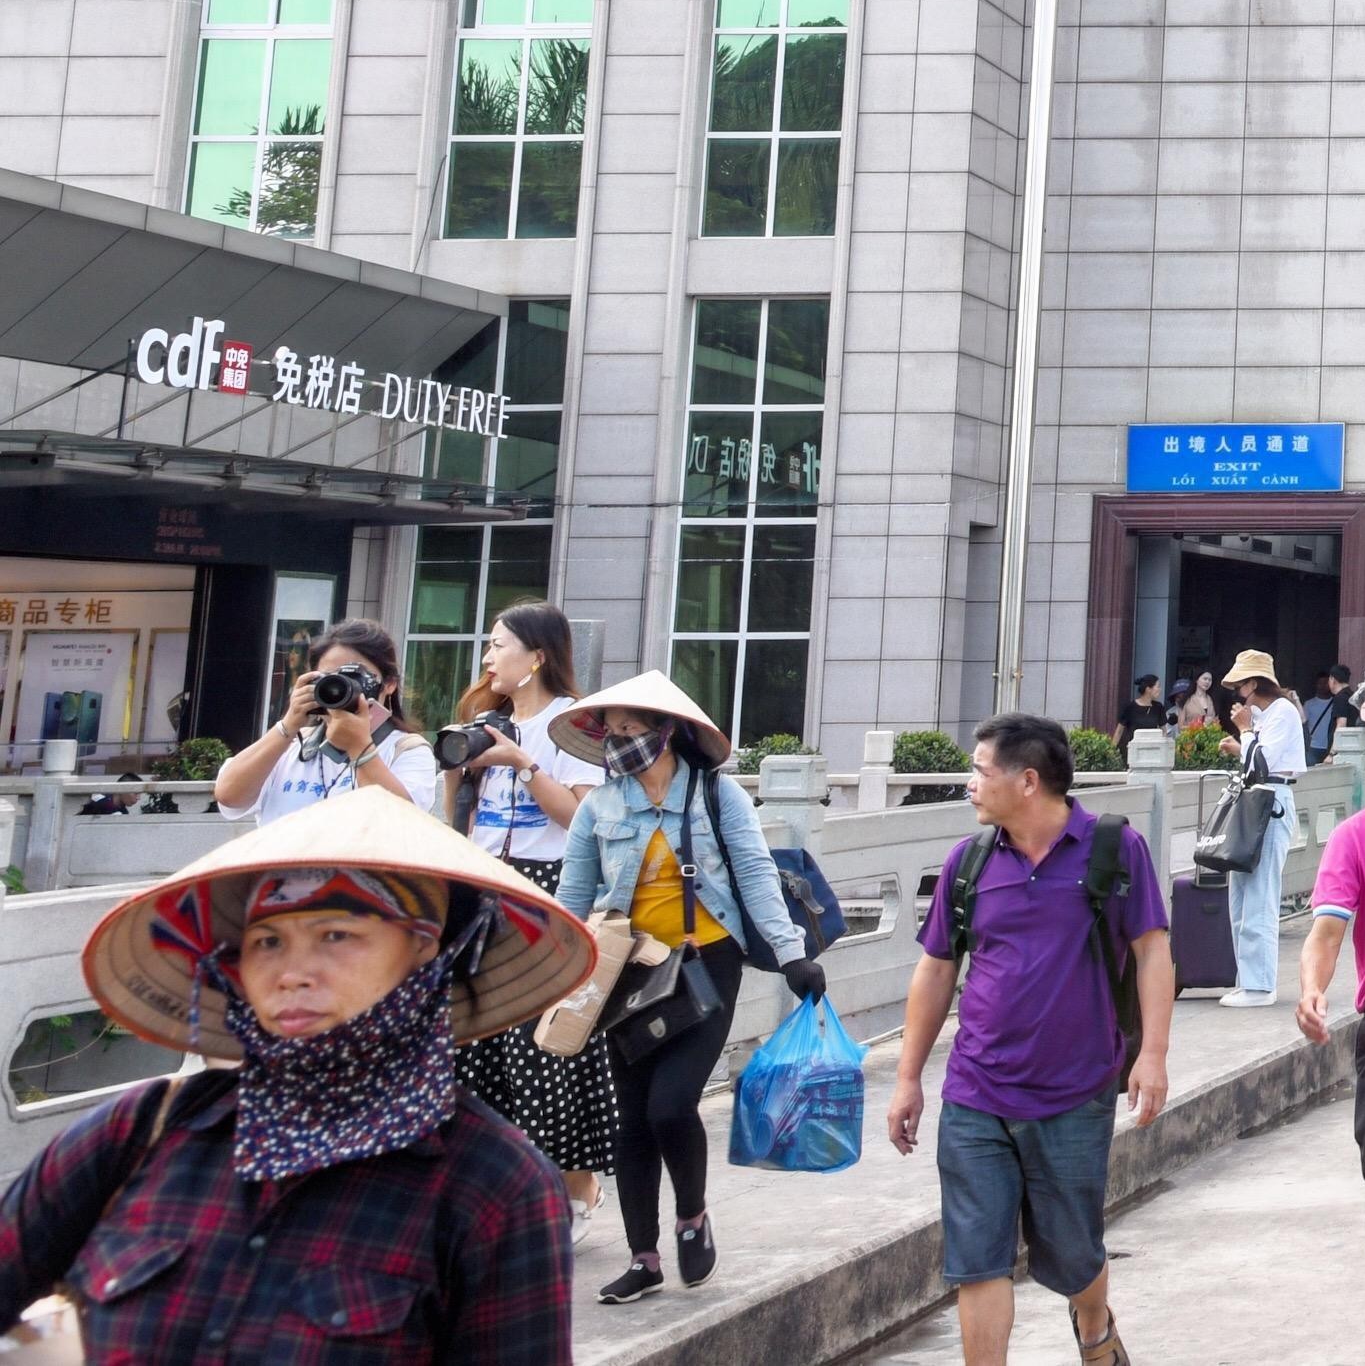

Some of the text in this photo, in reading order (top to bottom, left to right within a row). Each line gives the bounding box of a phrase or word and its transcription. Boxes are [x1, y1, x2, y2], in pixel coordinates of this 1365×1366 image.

[136, 316, 225, 391] cdf
[224, 347, 250, 369] 中免
[222, 369, 247, 391] 集团
[272, 349, 366, 415] 免税店
[381, 371, 512, 439] DUTY FREE
[1163, 435, 1310, 453] 出境人员通道
[1213, 462, 1262, 472] EXIT
[0, 597, 113, 625] 商品专柜
